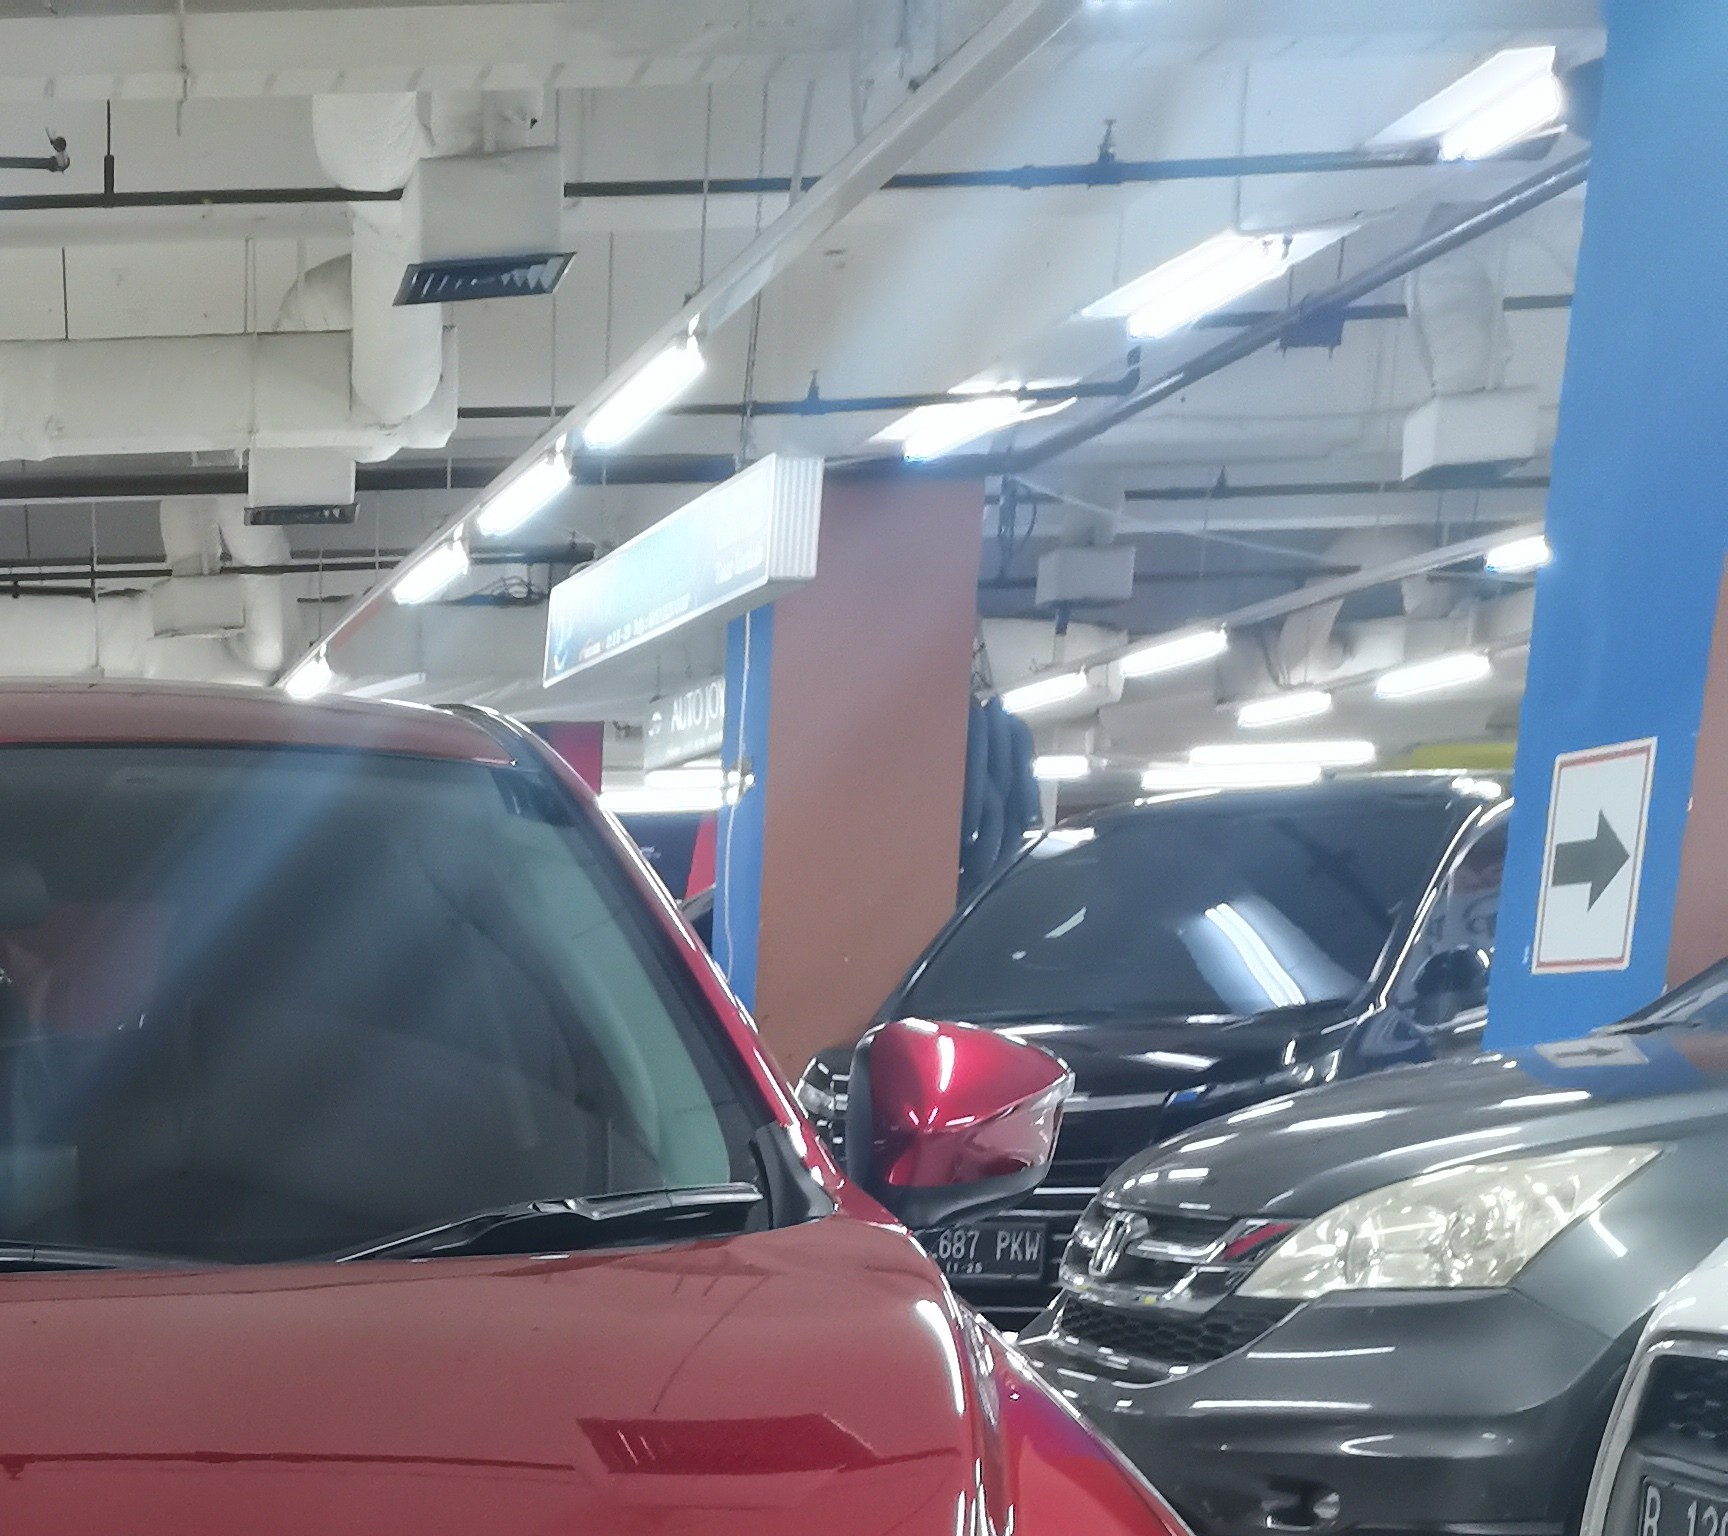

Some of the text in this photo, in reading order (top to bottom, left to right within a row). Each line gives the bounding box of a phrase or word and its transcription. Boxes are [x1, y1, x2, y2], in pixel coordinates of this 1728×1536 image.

[671, 689, 704, 731] AUTO
[932, 1228, 1041, 1262] 687 PKW
